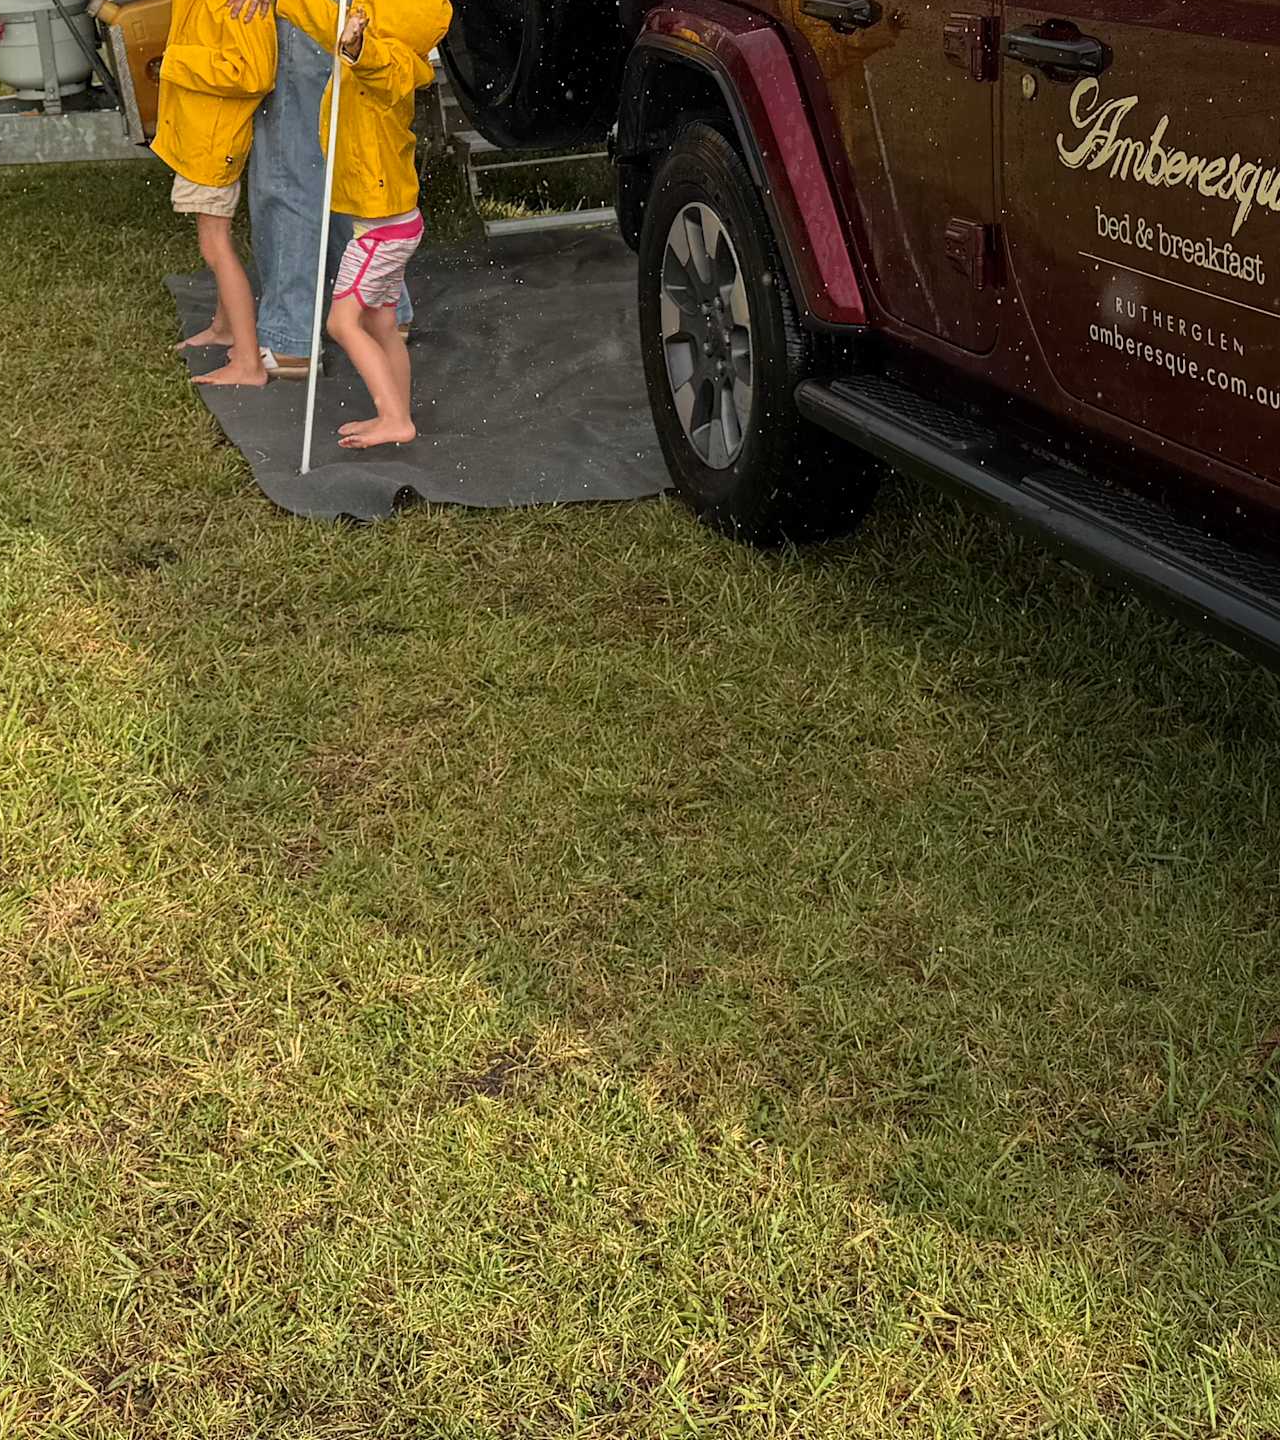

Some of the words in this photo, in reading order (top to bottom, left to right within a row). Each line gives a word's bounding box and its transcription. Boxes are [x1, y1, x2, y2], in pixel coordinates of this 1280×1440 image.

[1095, 205, 1132, 245] bed
[1135, 217, 1153, 250] &
[1157, 223, 1265, 285] breakfast
[1089, 324, 1280, 409] amberesque.com.au
[1115, 297, 1245, 357] RUTHERGLEN
